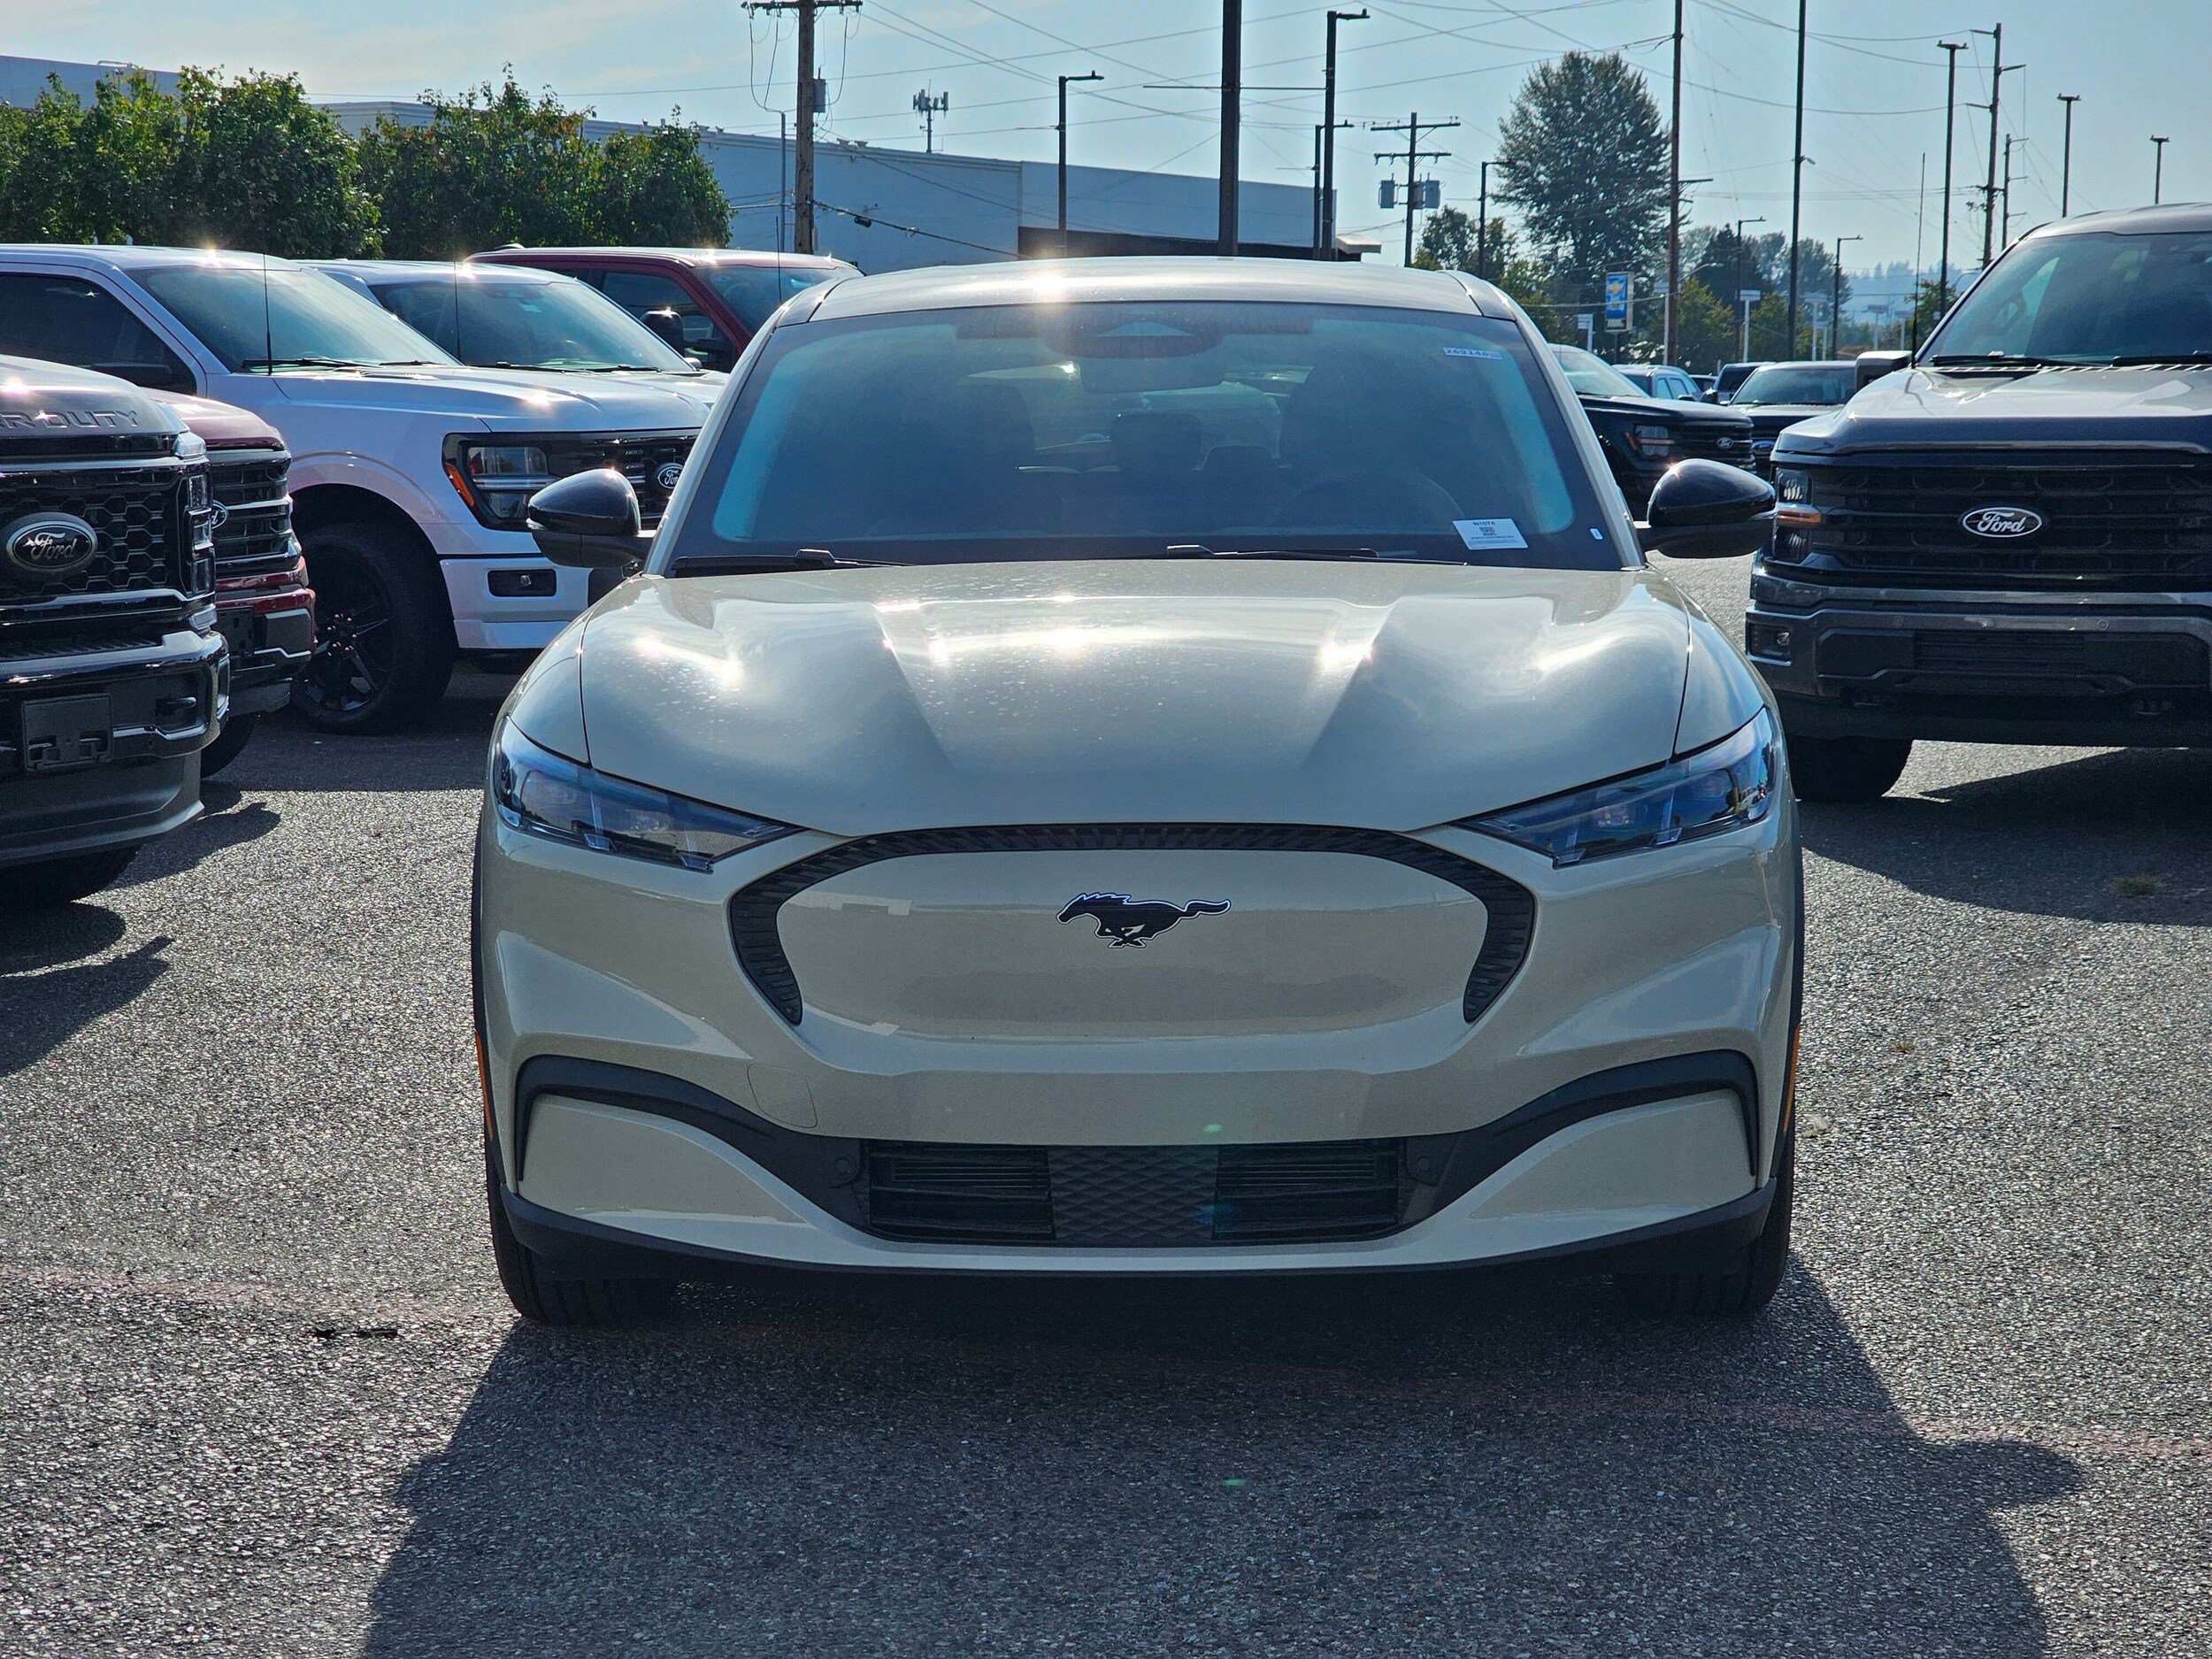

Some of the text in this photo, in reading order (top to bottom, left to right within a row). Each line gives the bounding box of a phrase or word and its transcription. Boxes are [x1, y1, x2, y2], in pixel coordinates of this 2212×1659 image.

[39, 411, 139, 428] DUTY
[664, 469, 680, 485] For
[1977, 511, 2026, 533] Ford
[30, 532, 78, 560] Ford
